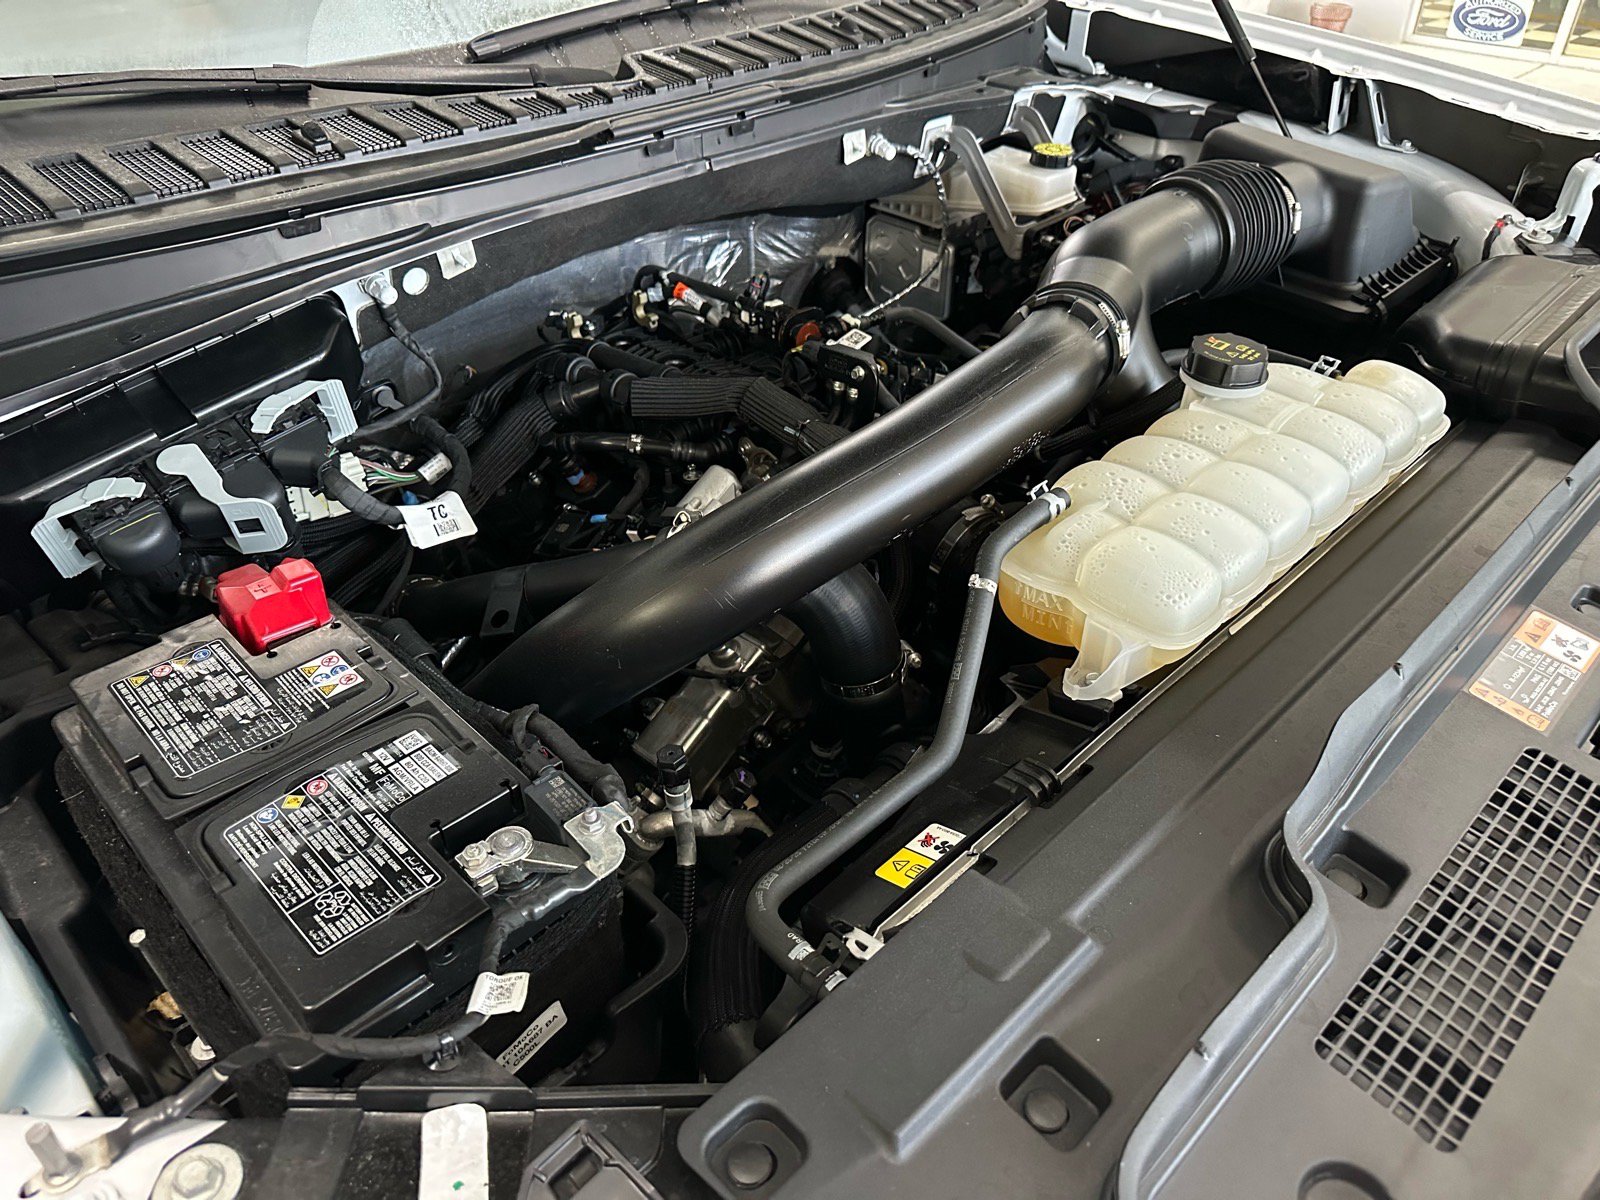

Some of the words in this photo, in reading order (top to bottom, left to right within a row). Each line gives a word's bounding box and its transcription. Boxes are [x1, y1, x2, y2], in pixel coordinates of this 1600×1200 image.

[1467, 8, 1512, 28] Ford
[1463, 27, 1505, 42] SERVICE
[427, 504, 448, 520] TC
[1022, 586, 1063, 612] MAX
[1022, 603, 1059, 630] MIN
[378, 752, 390, 761] 12V
[369, 763, 386, 776] MF
[418, 773, 429, 783] C20
[380, 777, 408, 801] FoMoCo
[502, 1024, 539, 1061] FoMoCo
